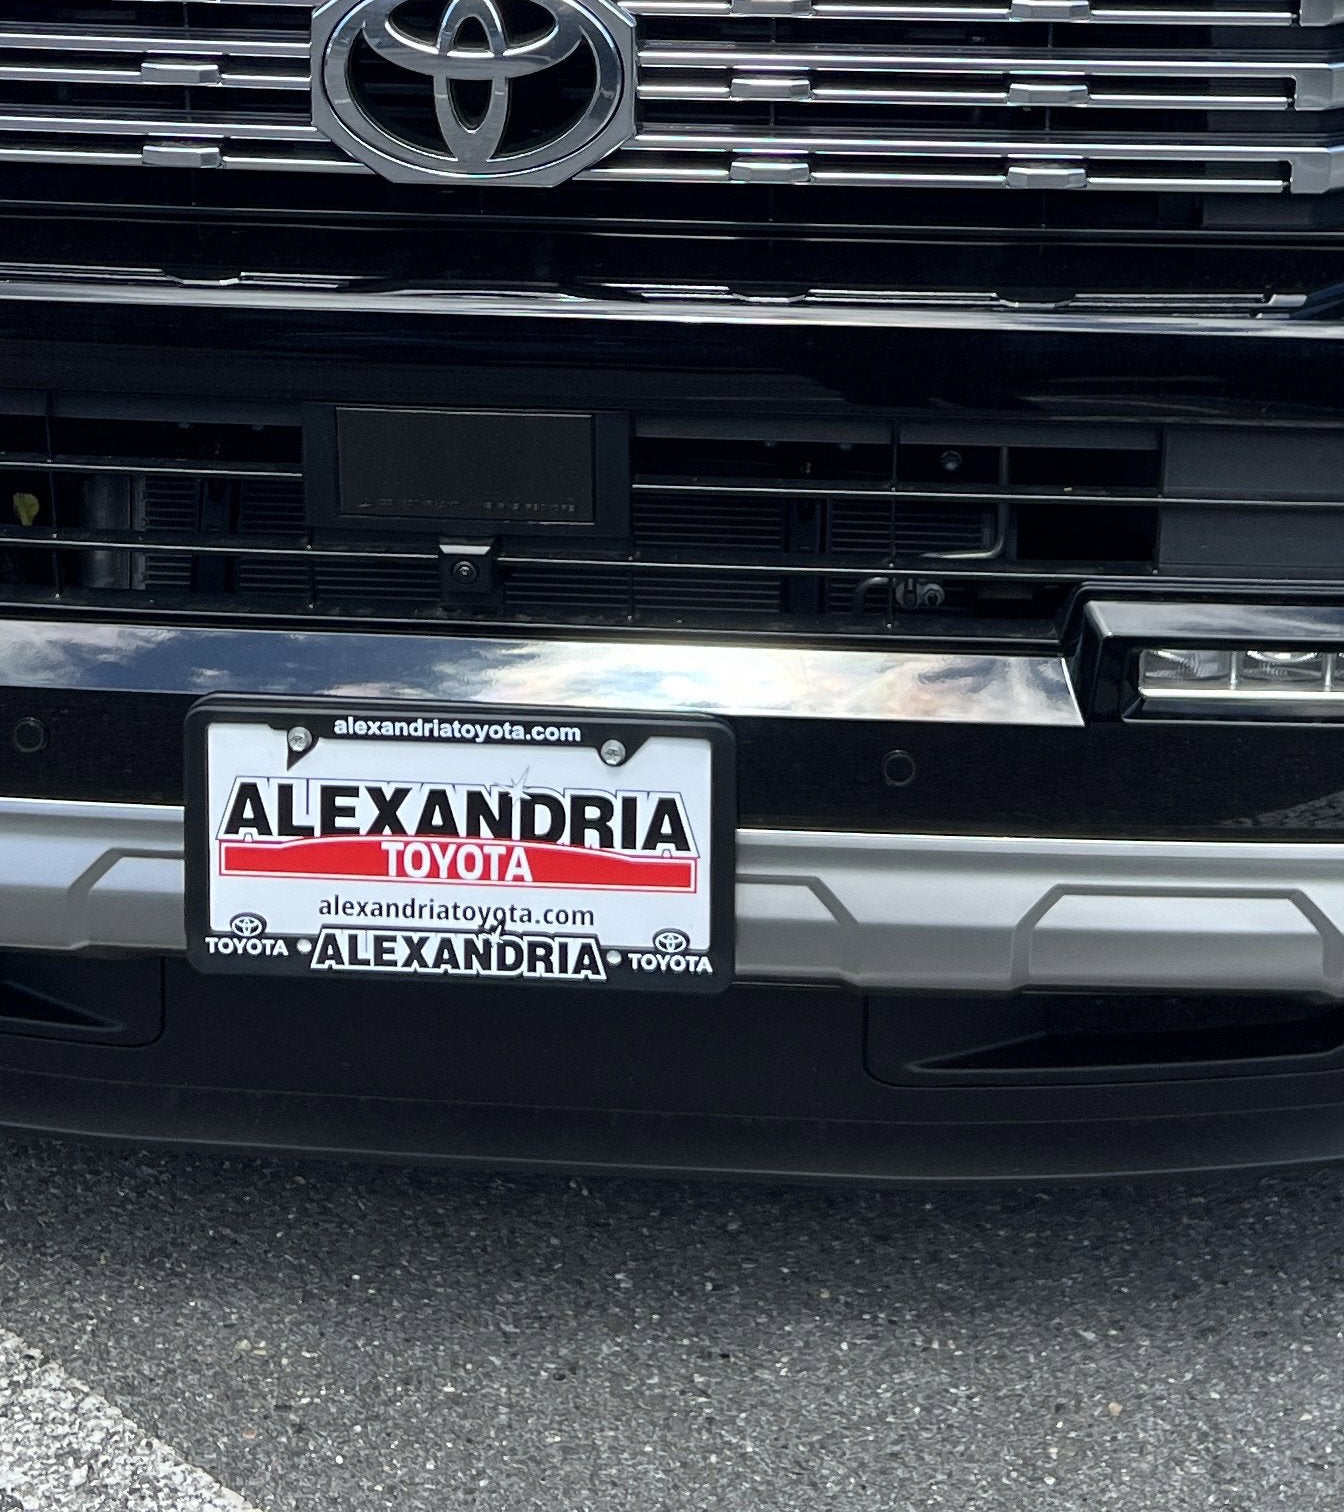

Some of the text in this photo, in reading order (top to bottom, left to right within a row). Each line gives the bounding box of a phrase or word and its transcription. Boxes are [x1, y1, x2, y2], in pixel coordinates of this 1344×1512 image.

[333, 716, 581, 743] alexandriatoyota.com
[221, 781, 692, 854] ALEXANDRIA
[380, 841, 534, 883] TOYOTA
[318, 893, 595, 926] alexandriatoyota.com
[204, 935, 289, 957] TOYOTA
[313, 929, 605, 979] ALEXANDRIA
[628, 952, 713, 975] TOYOTA
